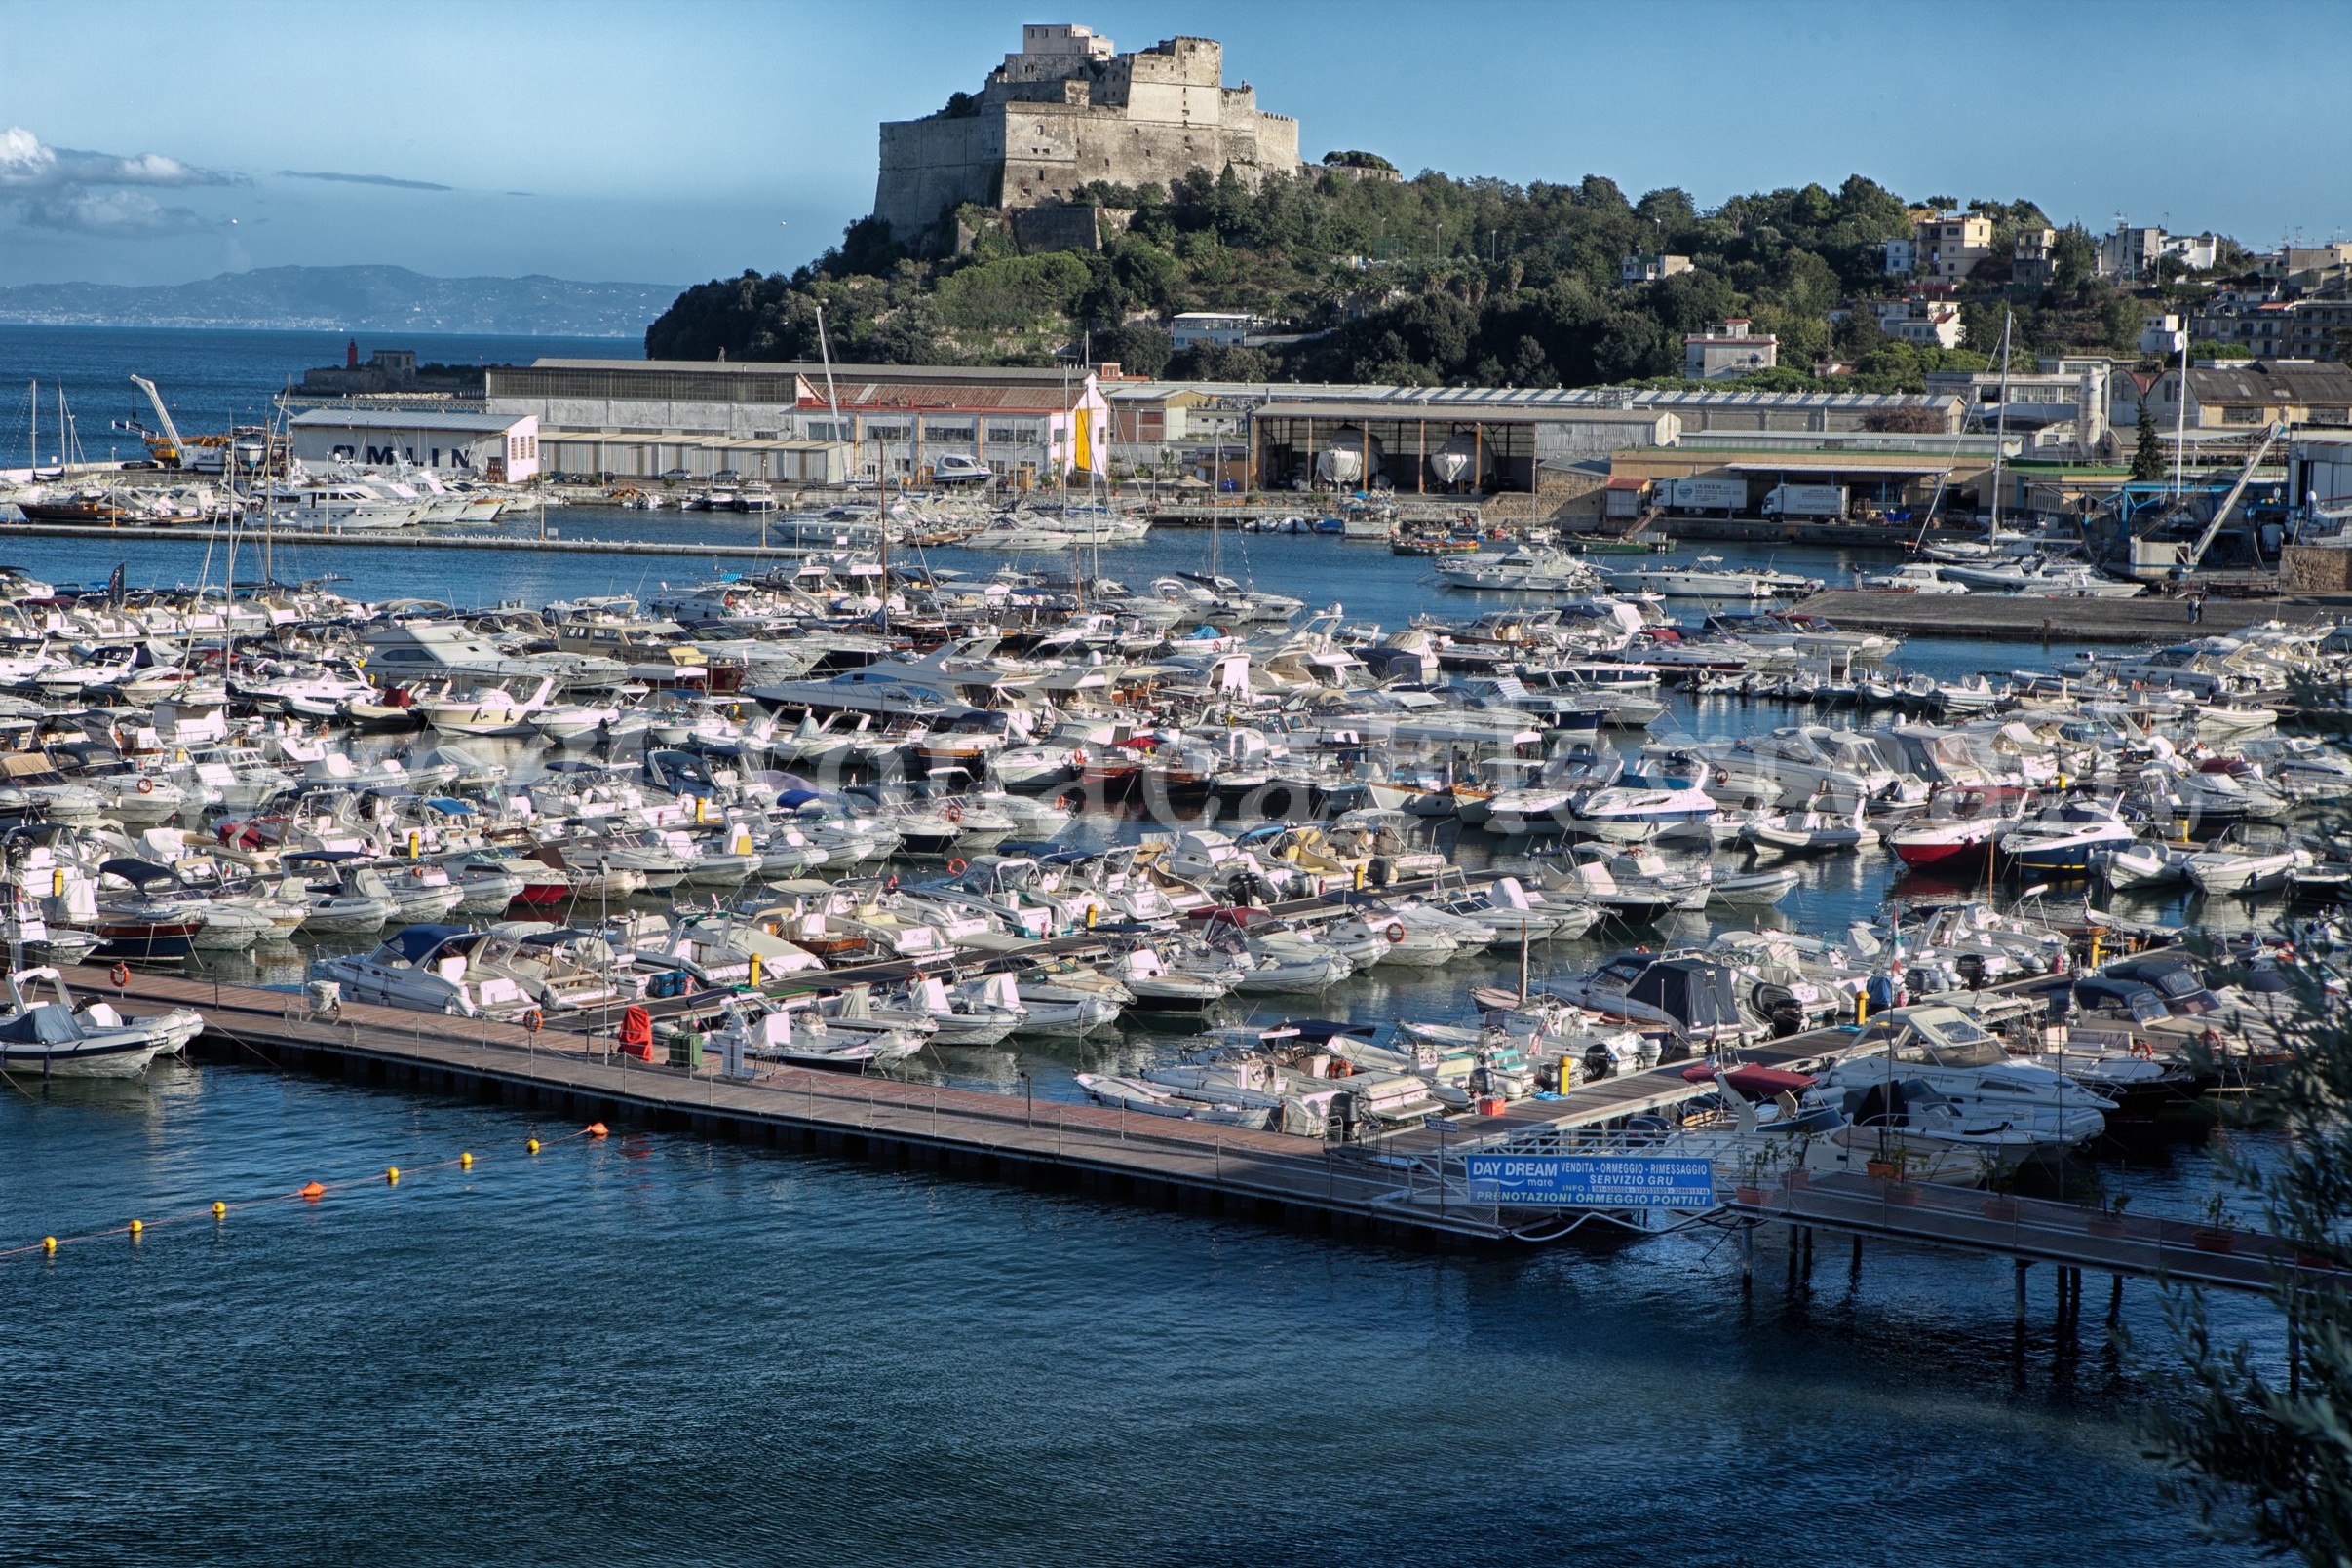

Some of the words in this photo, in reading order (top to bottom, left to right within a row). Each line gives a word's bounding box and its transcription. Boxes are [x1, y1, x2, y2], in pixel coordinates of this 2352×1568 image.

[1473, 1162, 1502, 1176] DAY
[1505, 1163, 1558, 1177] DREAM
[1561, 1162, 1594, 1174] VENDITA
[1600, 1163, 1643, 1175] ORMEGGIO
[1650, 1164, 1707, 1175] RIMESSAGGIO
[1527, 1177, 1554, 1187] mare
[1589, 1174, 1644, 1185] SERVIZIO
[1647, 1175, 1674, 1186] GRU
[1477, 1191, 1571, 1203] PRENOTAZIONI
[1575, 1193, 1648, 1205] ORMEGGIO
[1652, 1194, 1707, 1205] PONTILI
